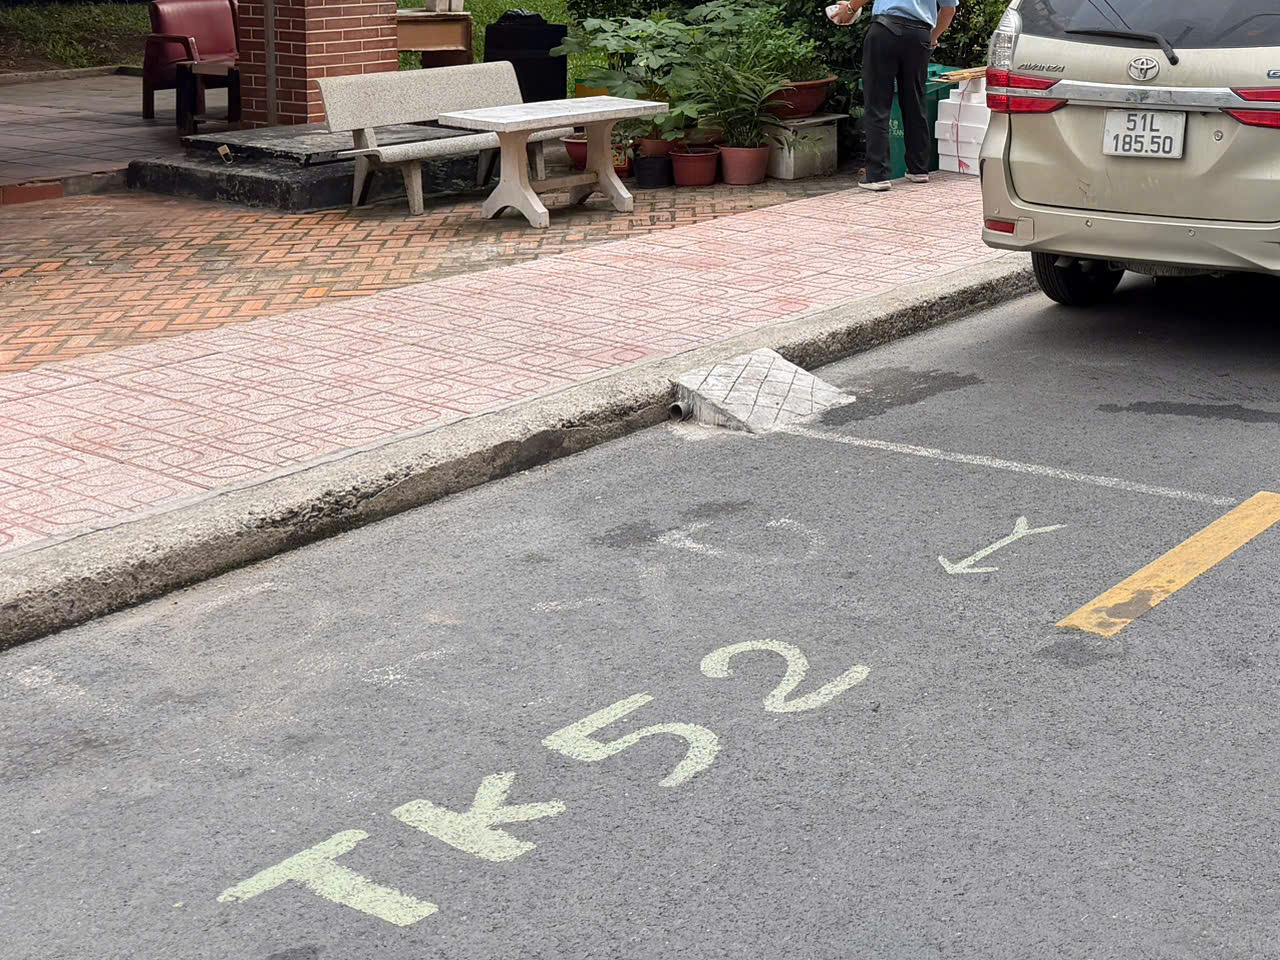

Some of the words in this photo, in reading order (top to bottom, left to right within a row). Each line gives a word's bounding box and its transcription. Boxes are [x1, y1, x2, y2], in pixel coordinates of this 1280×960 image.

[1017, 63, 1065, 72] AVANZA
[1126, 113, 1160, 132] 51L
[1113, 133, 1174, 154] 185.50
